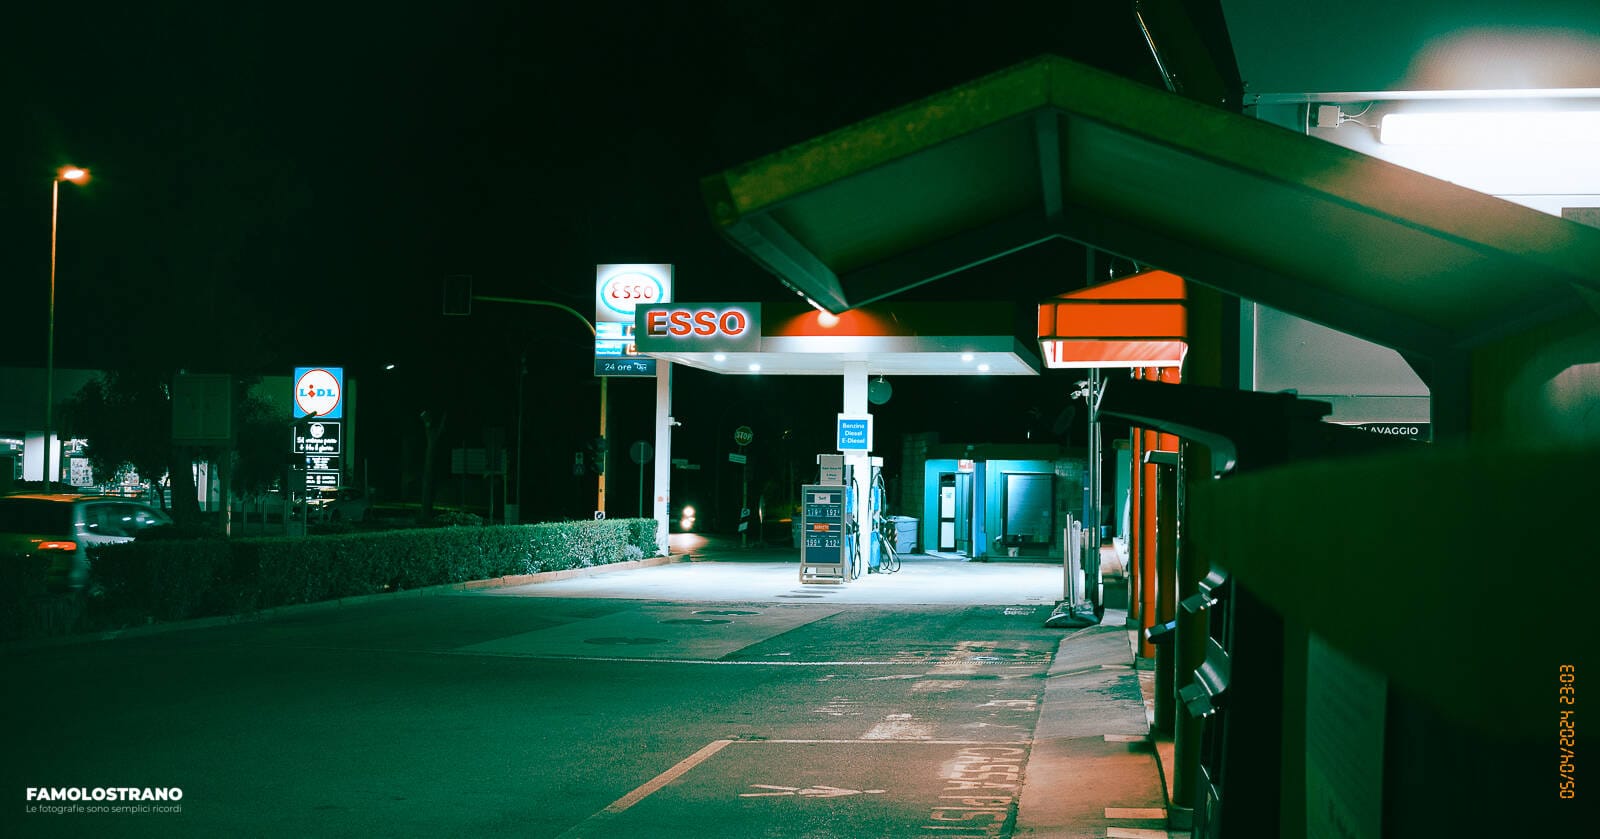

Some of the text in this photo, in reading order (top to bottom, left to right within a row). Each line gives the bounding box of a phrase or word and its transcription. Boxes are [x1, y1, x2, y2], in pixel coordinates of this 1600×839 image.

[646, 310, 746, 336] ESSO
[604, 363, 615, 371] 24
[735, 431, 752, 441] STOP
[920, 795, 1013, 839] PIST
